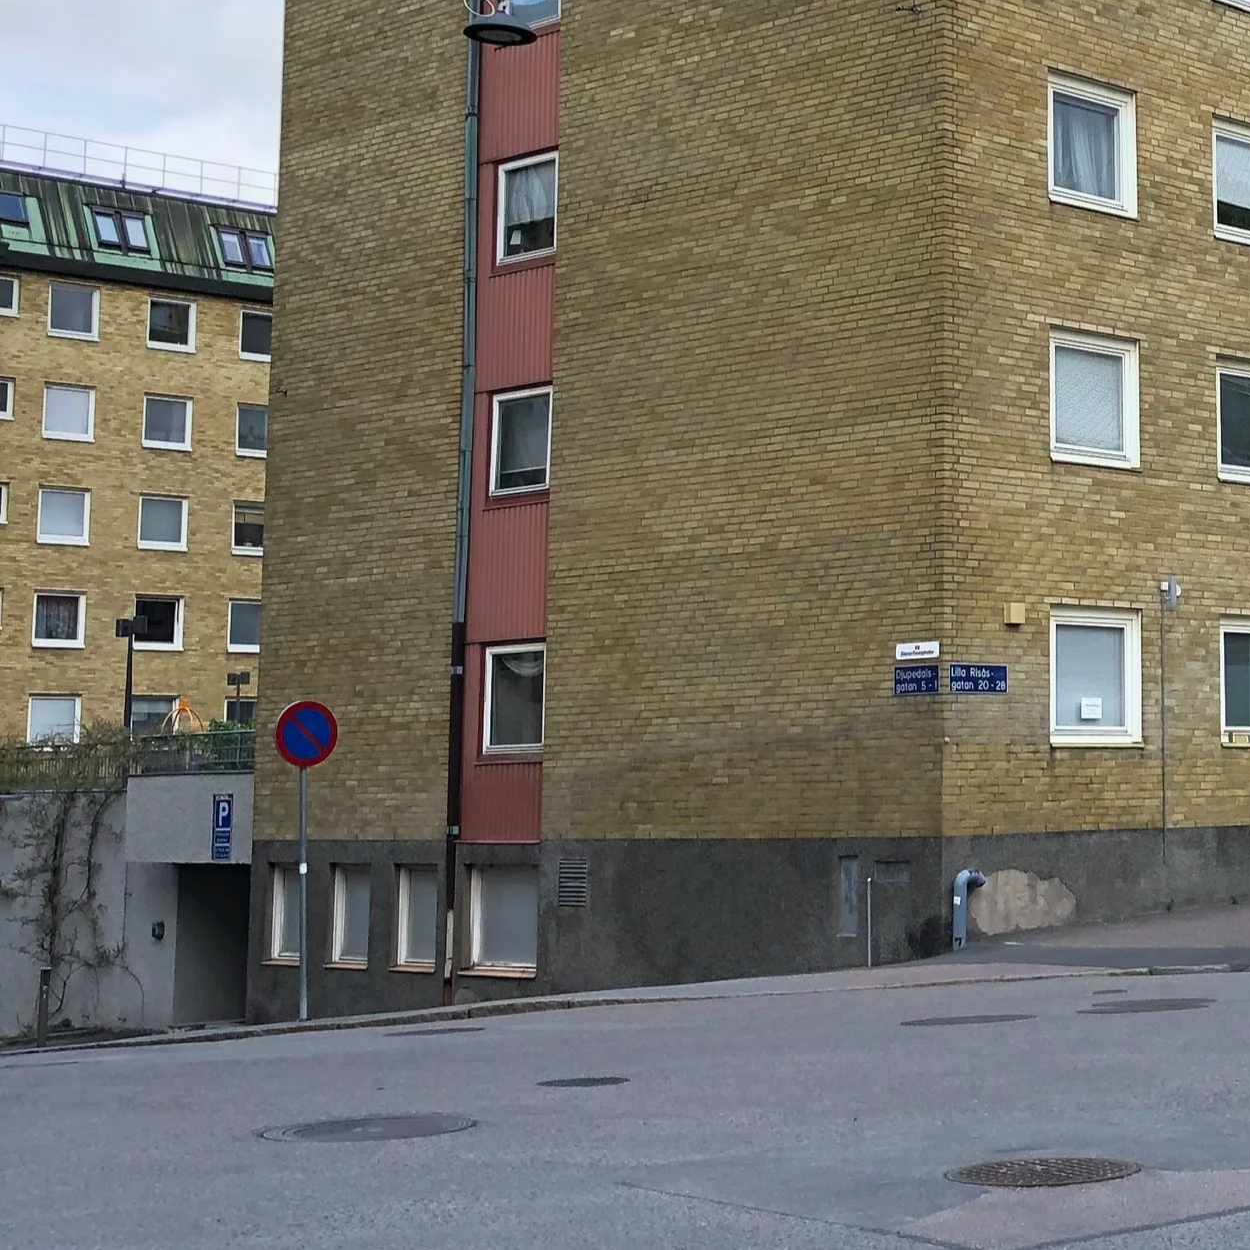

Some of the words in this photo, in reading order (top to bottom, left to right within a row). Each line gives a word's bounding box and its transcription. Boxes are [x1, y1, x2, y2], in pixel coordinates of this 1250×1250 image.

[951, 666, 966, 677] Lilla
[896, 681, 917, 693] gatan
[951, 680, 974, 691] gatan
[219, 802, 229, 826] P
